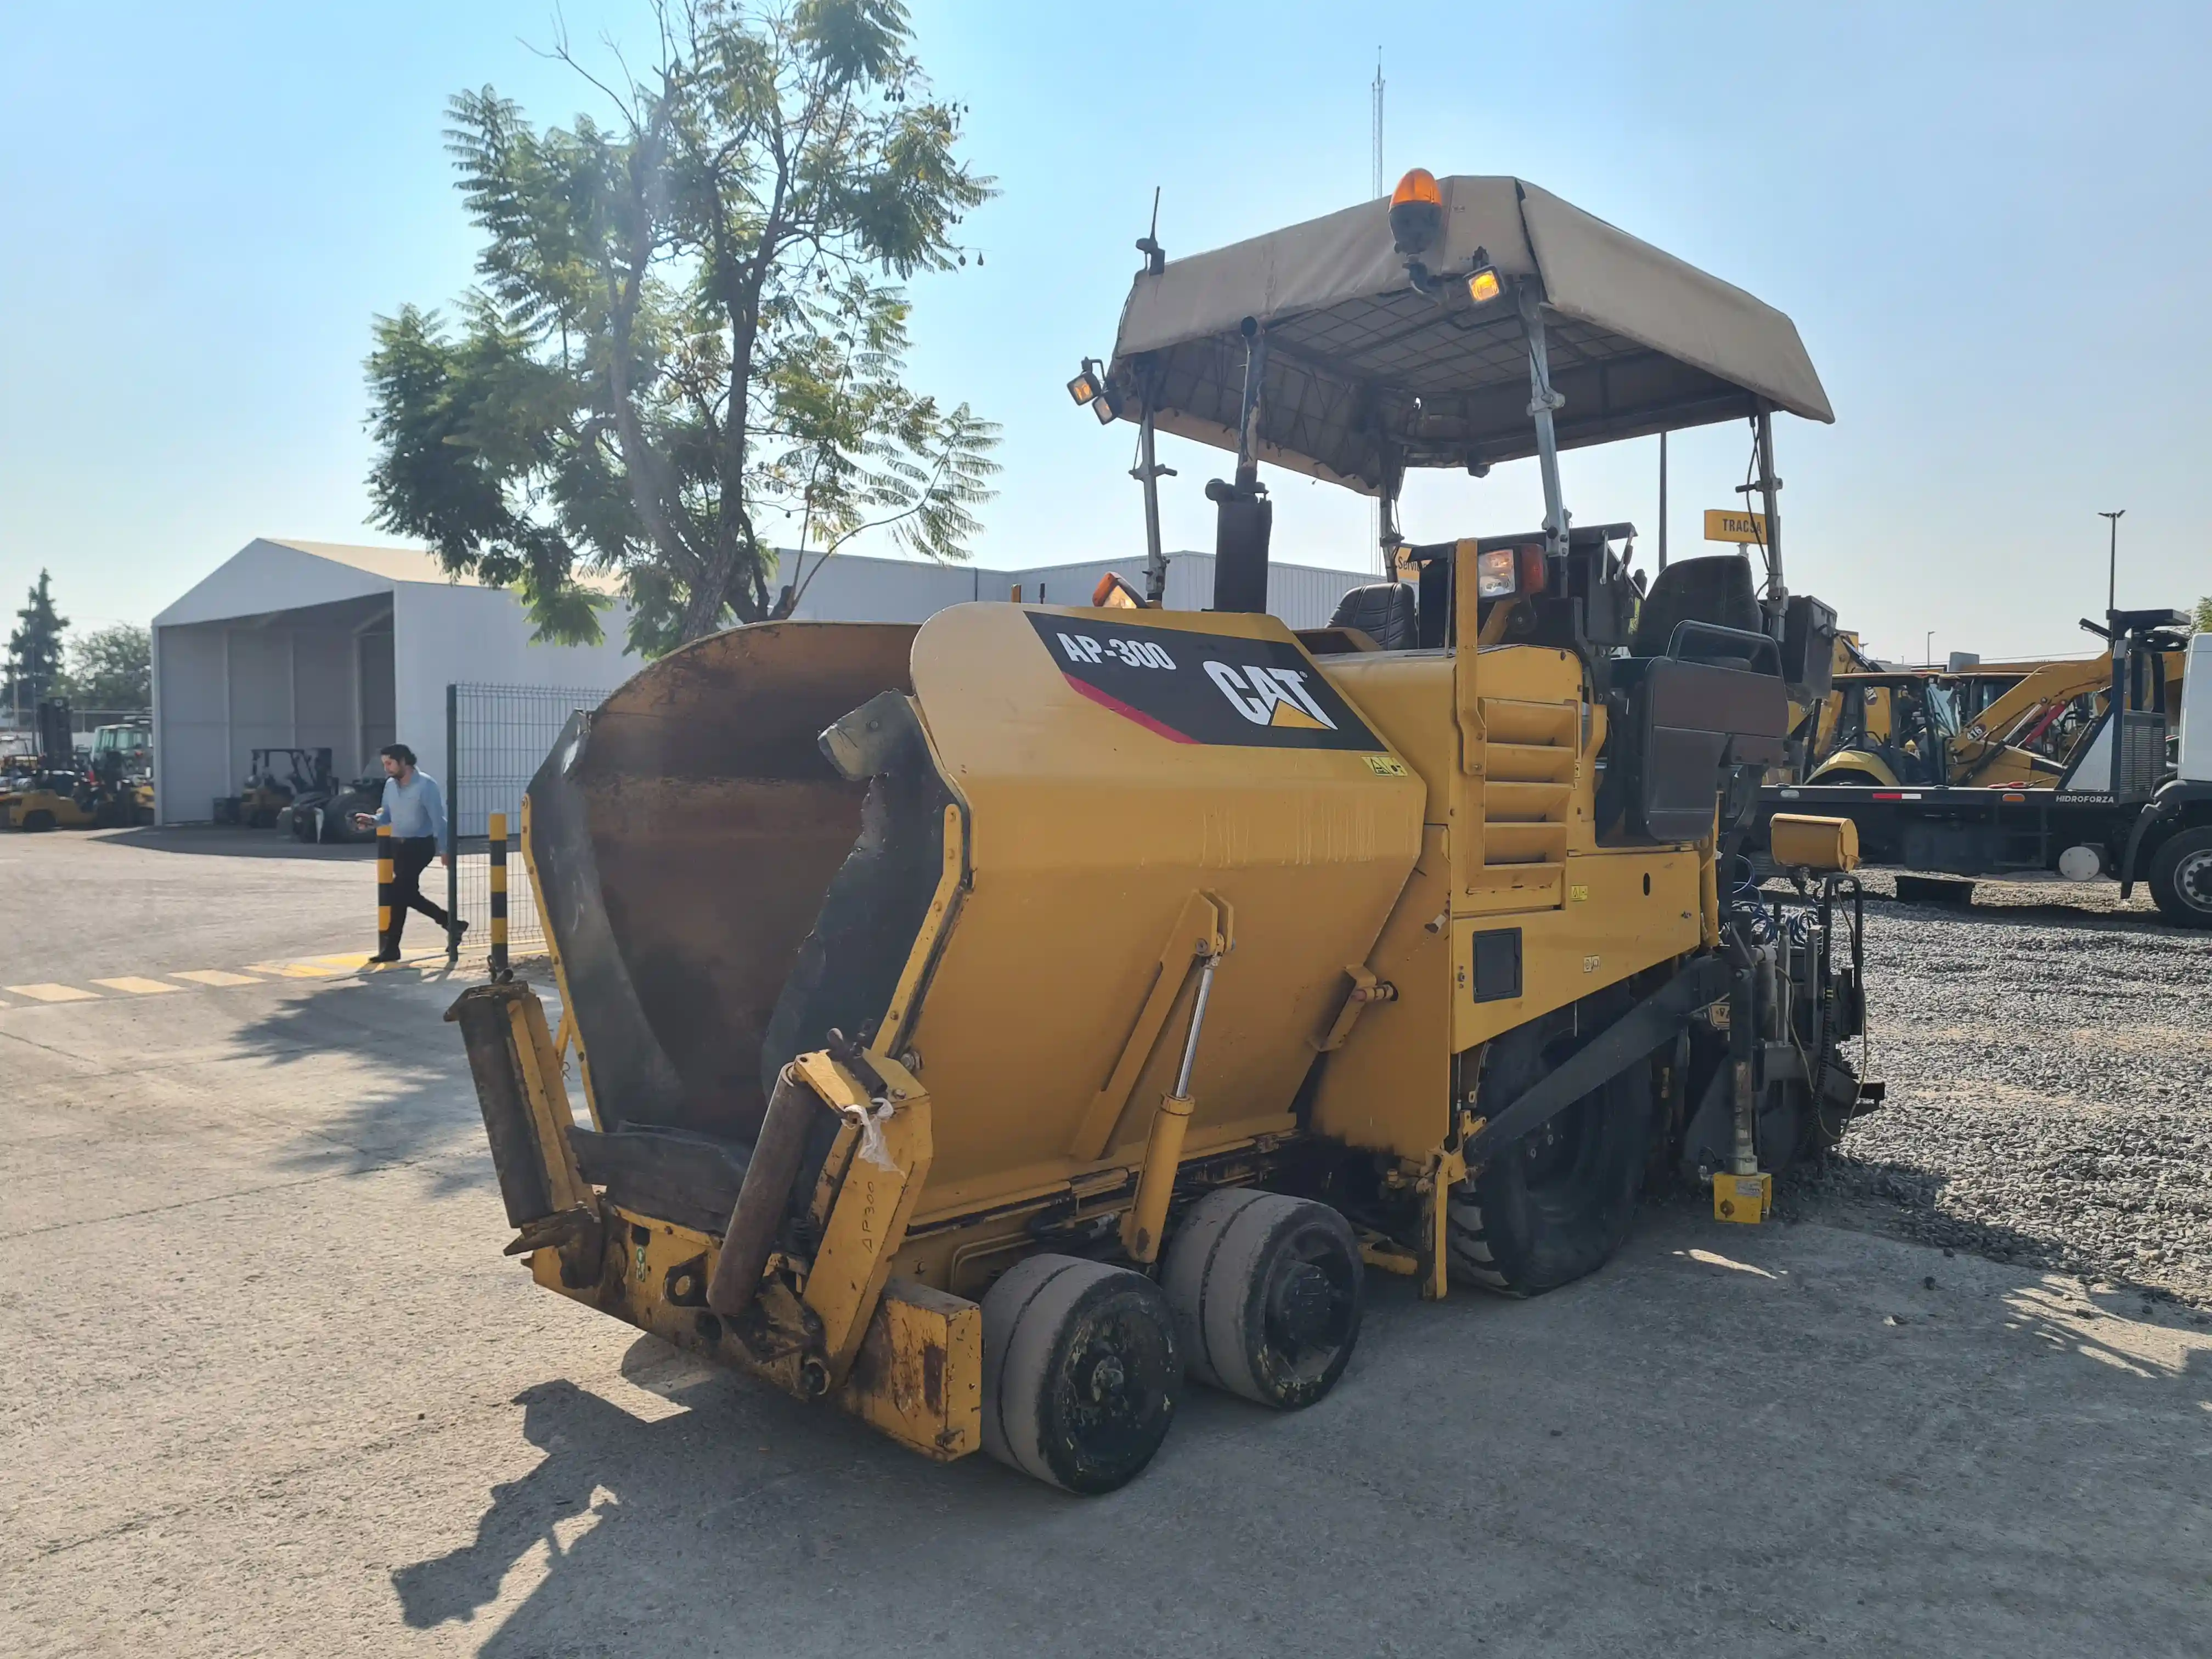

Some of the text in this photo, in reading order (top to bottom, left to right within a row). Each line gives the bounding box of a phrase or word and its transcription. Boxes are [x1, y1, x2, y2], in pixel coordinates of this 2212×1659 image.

[1056, 633, 1176, 670] AP-300
[1203, 661, 1338, 730] CAT
[1967, 726, 1983, 740] 416
[2056, 795, 2114, 803] HIDROFORZA
